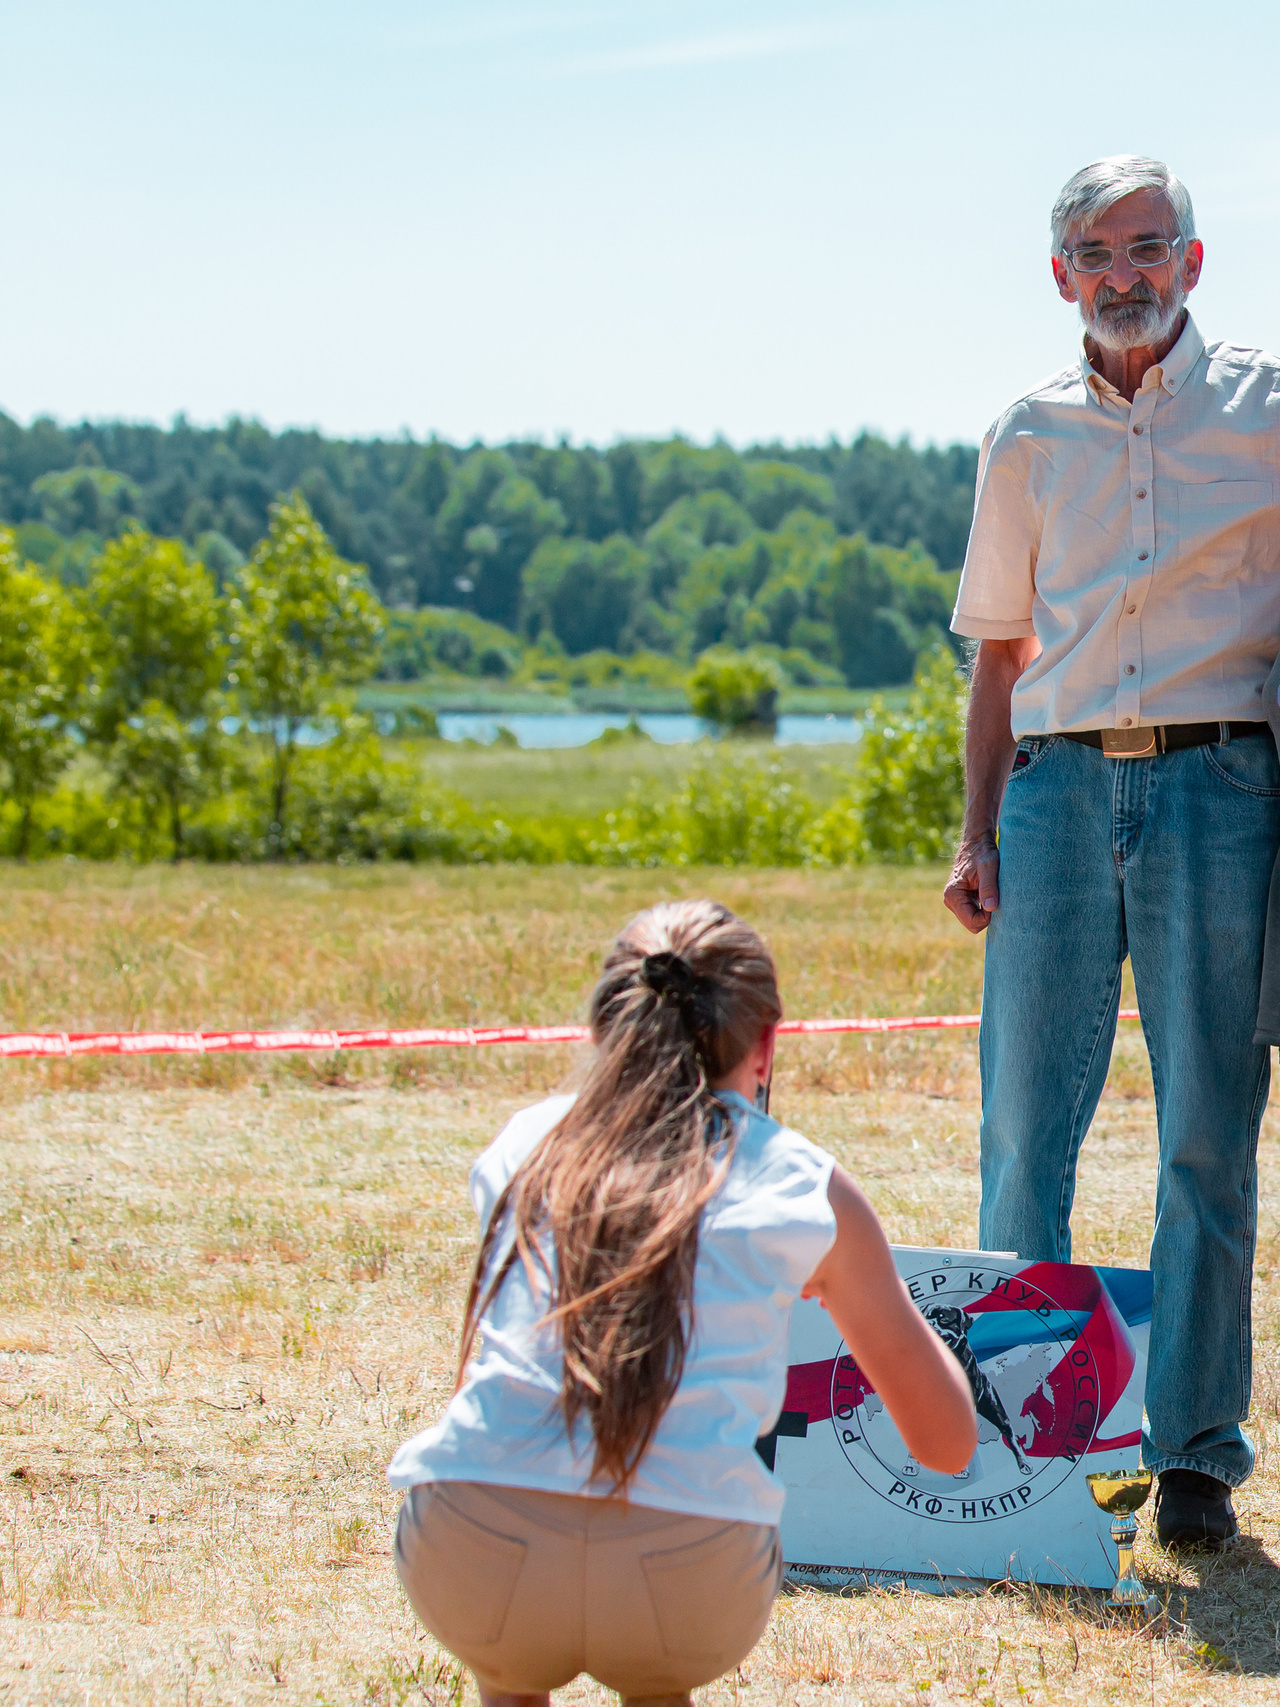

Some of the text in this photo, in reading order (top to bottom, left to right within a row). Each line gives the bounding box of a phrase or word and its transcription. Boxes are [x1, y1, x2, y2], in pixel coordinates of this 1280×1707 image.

[968, 1272, 1055, 1318] КЛУБ
[1059, 1327, 1095, 1464] РОССИИ
[888, 1481, 1032, 1518] РКФ-НКПР
